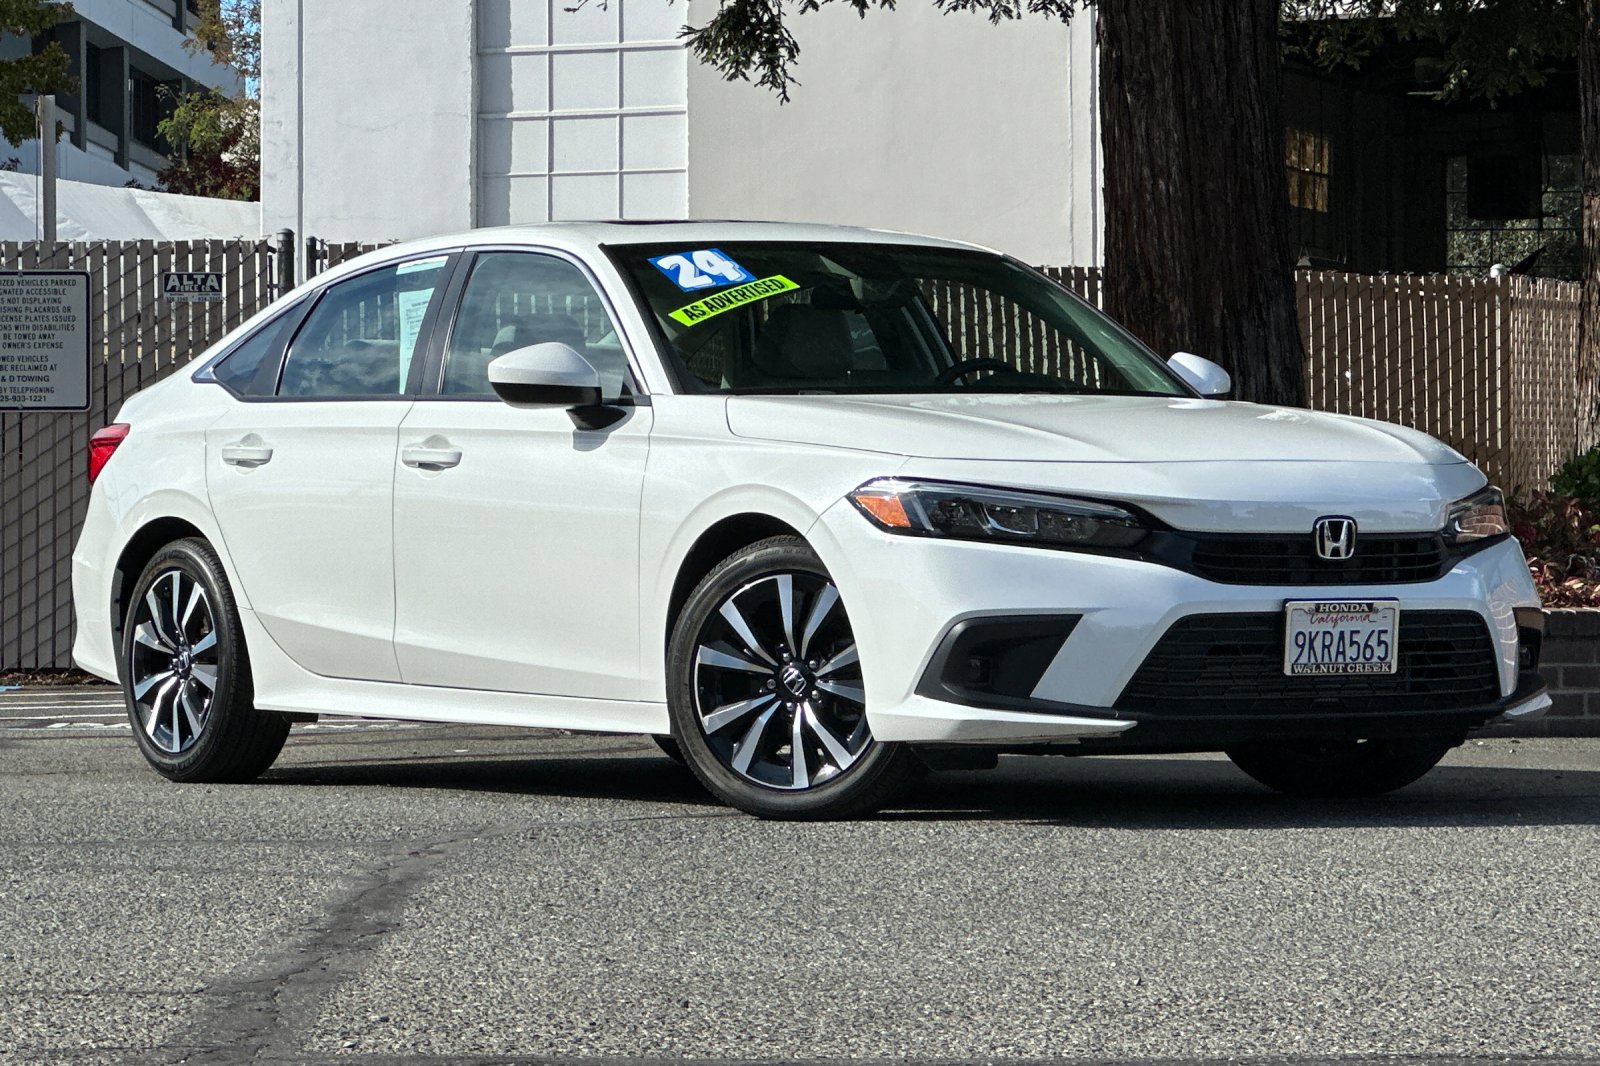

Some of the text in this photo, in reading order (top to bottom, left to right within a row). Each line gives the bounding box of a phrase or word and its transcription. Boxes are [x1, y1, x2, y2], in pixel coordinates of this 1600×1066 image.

[657, 250, 746, 288] 24
[166, 274, 220, 290] ALTA
[681, 278, 786, 321] AS ADVERTISED
[1320, 603, 1369, 612] HONDA
[1310, 612, 1377, 628] California
[1294, 629, 1388, 664] 9KRA565
[1293, 664, 1390, 674] WALNUT CREEK
